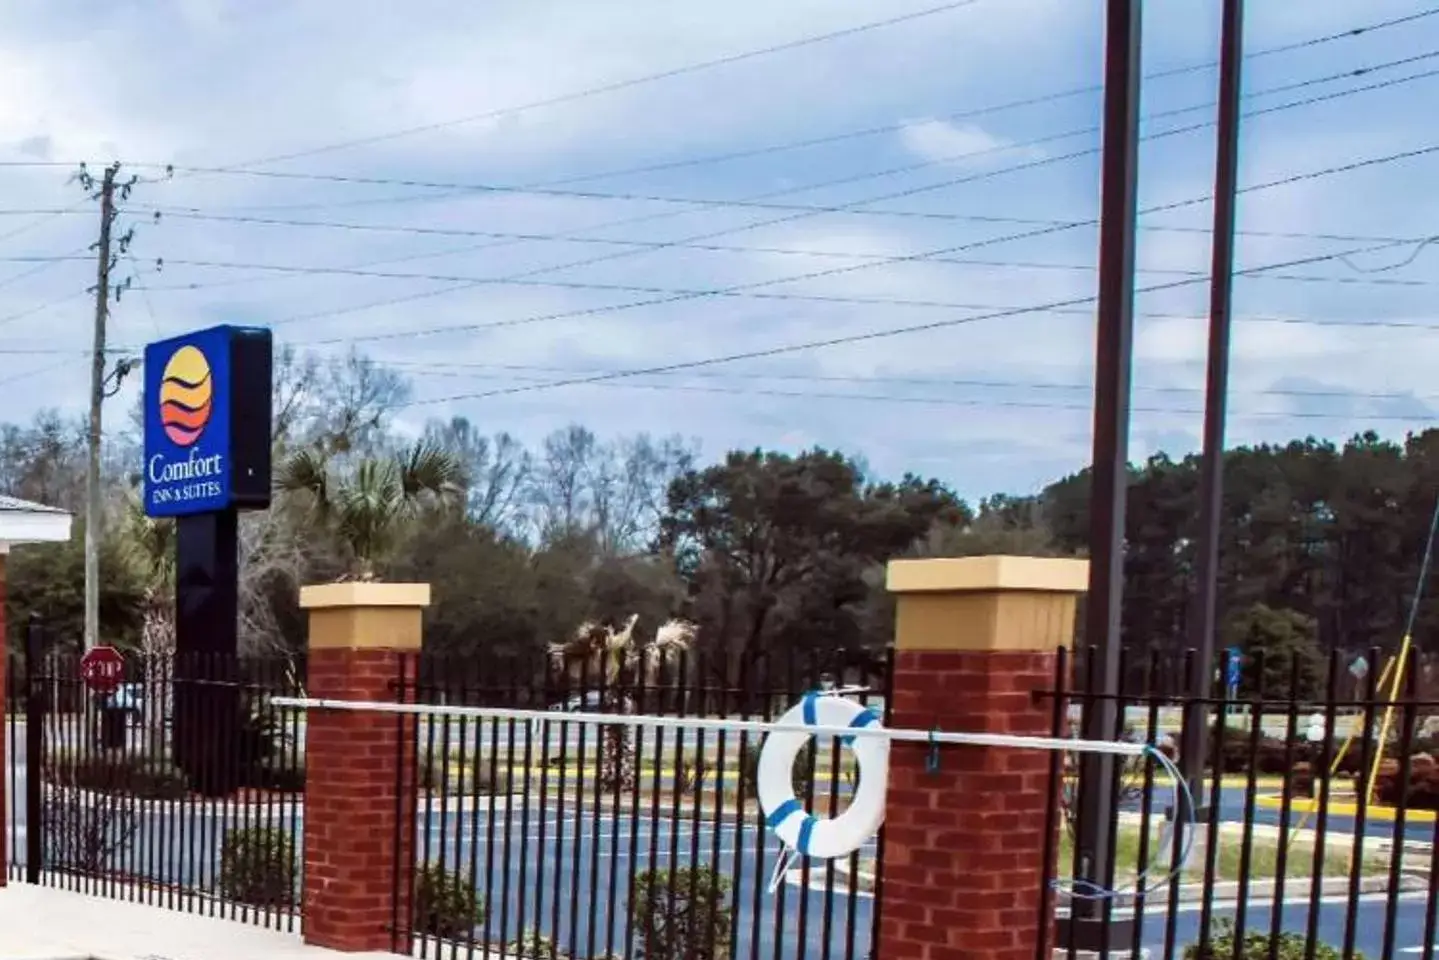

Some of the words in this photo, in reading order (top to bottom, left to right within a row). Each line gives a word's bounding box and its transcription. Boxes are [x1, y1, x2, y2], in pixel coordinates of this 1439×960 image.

[149, 447, 222, 484] Comfort
[152, 488, 173, 504] INN
[183, 482, 221, 500] SUITES
